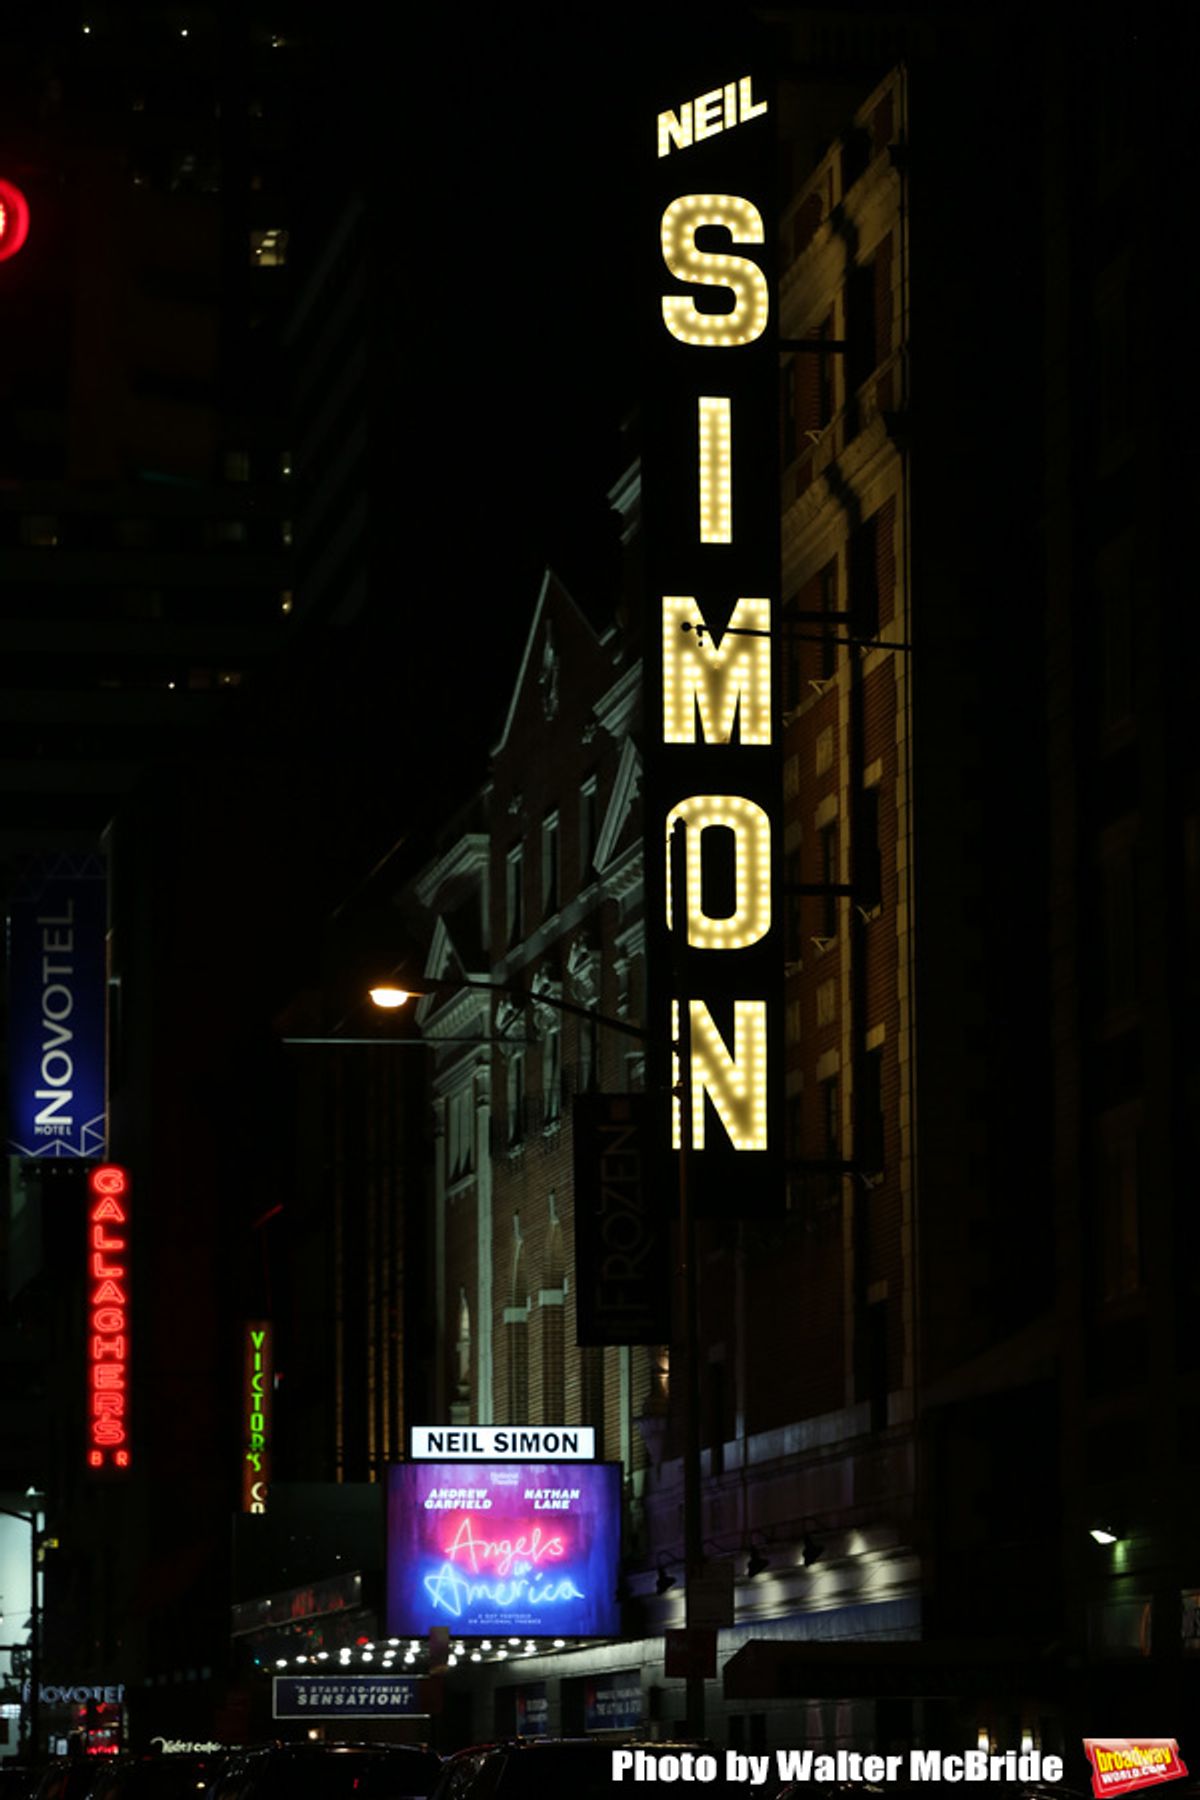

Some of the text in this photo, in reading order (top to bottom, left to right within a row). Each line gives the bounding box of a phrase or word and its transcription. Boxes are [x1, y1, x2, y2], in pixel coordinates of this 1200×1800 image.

[657, 76, 768, 158] NEIL
[660, 194, 772, 1151] SIMON
[35, 899, 73, 1125] NOVOTEL
[35, 1126, 72, 1136] HOTEL
[428, 1432, 578, 1453] NEIL SIMON
[424, 1499, 570, 1510] GARFIELD LANE
[429, 1488, 580, 1499] ANDREW NATHAN
[445, 1517, 564, 1575] Angels
[423, 1563, 585, 1616] America
